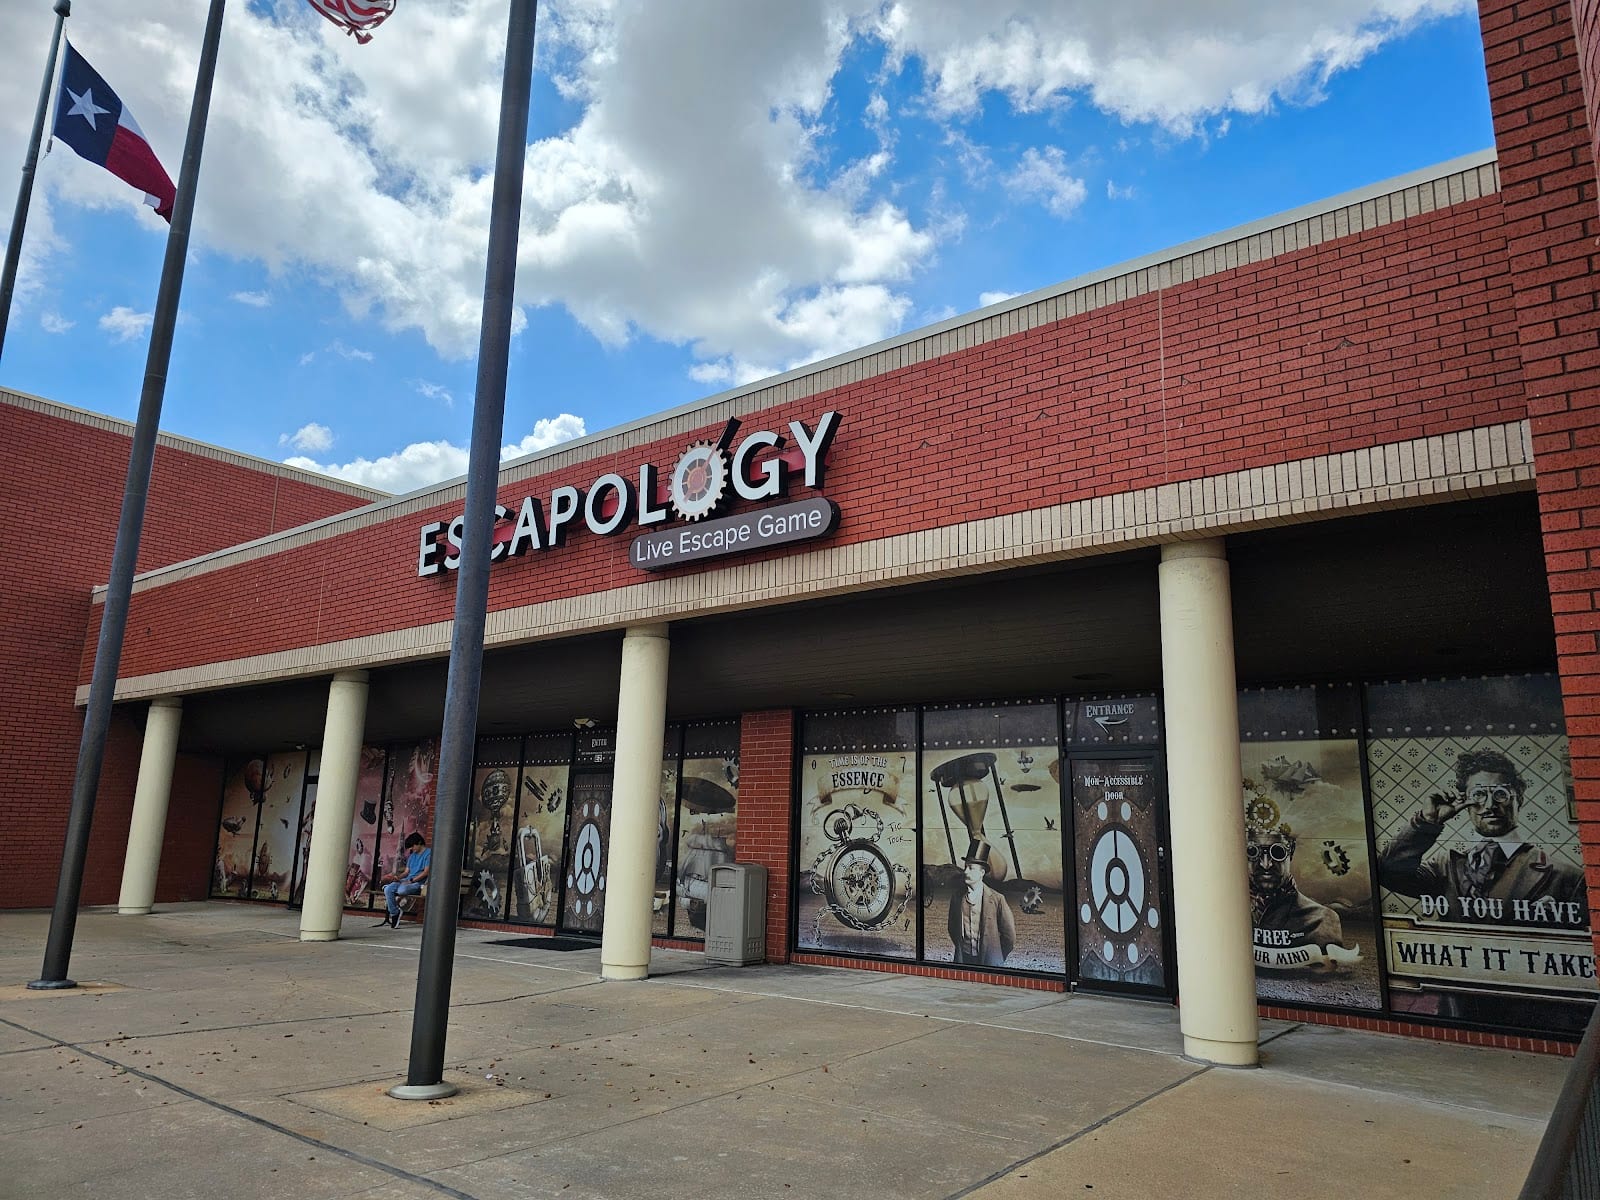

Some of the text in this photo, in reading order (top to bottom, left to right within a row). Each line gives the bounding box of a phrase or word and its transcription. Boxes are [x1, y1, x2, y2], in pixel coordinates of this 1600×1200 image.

[636, 509, 821, 562] Live Escape Game
[1086, 703, 1134, 718] ENTRANCE
[829, 755, 888, 770] TIME IS OF THE
[832, 771, 885, 792] ESSENCE
[1420, 894, 1582, 925] DO YOU HAVE
[1253, 928, 1291, 946] FREE
[1276, 949, 1310, 965] MIND
[1396, 941, 1472, 969] WHAT
[1482, 947, 1511, 971] IT
